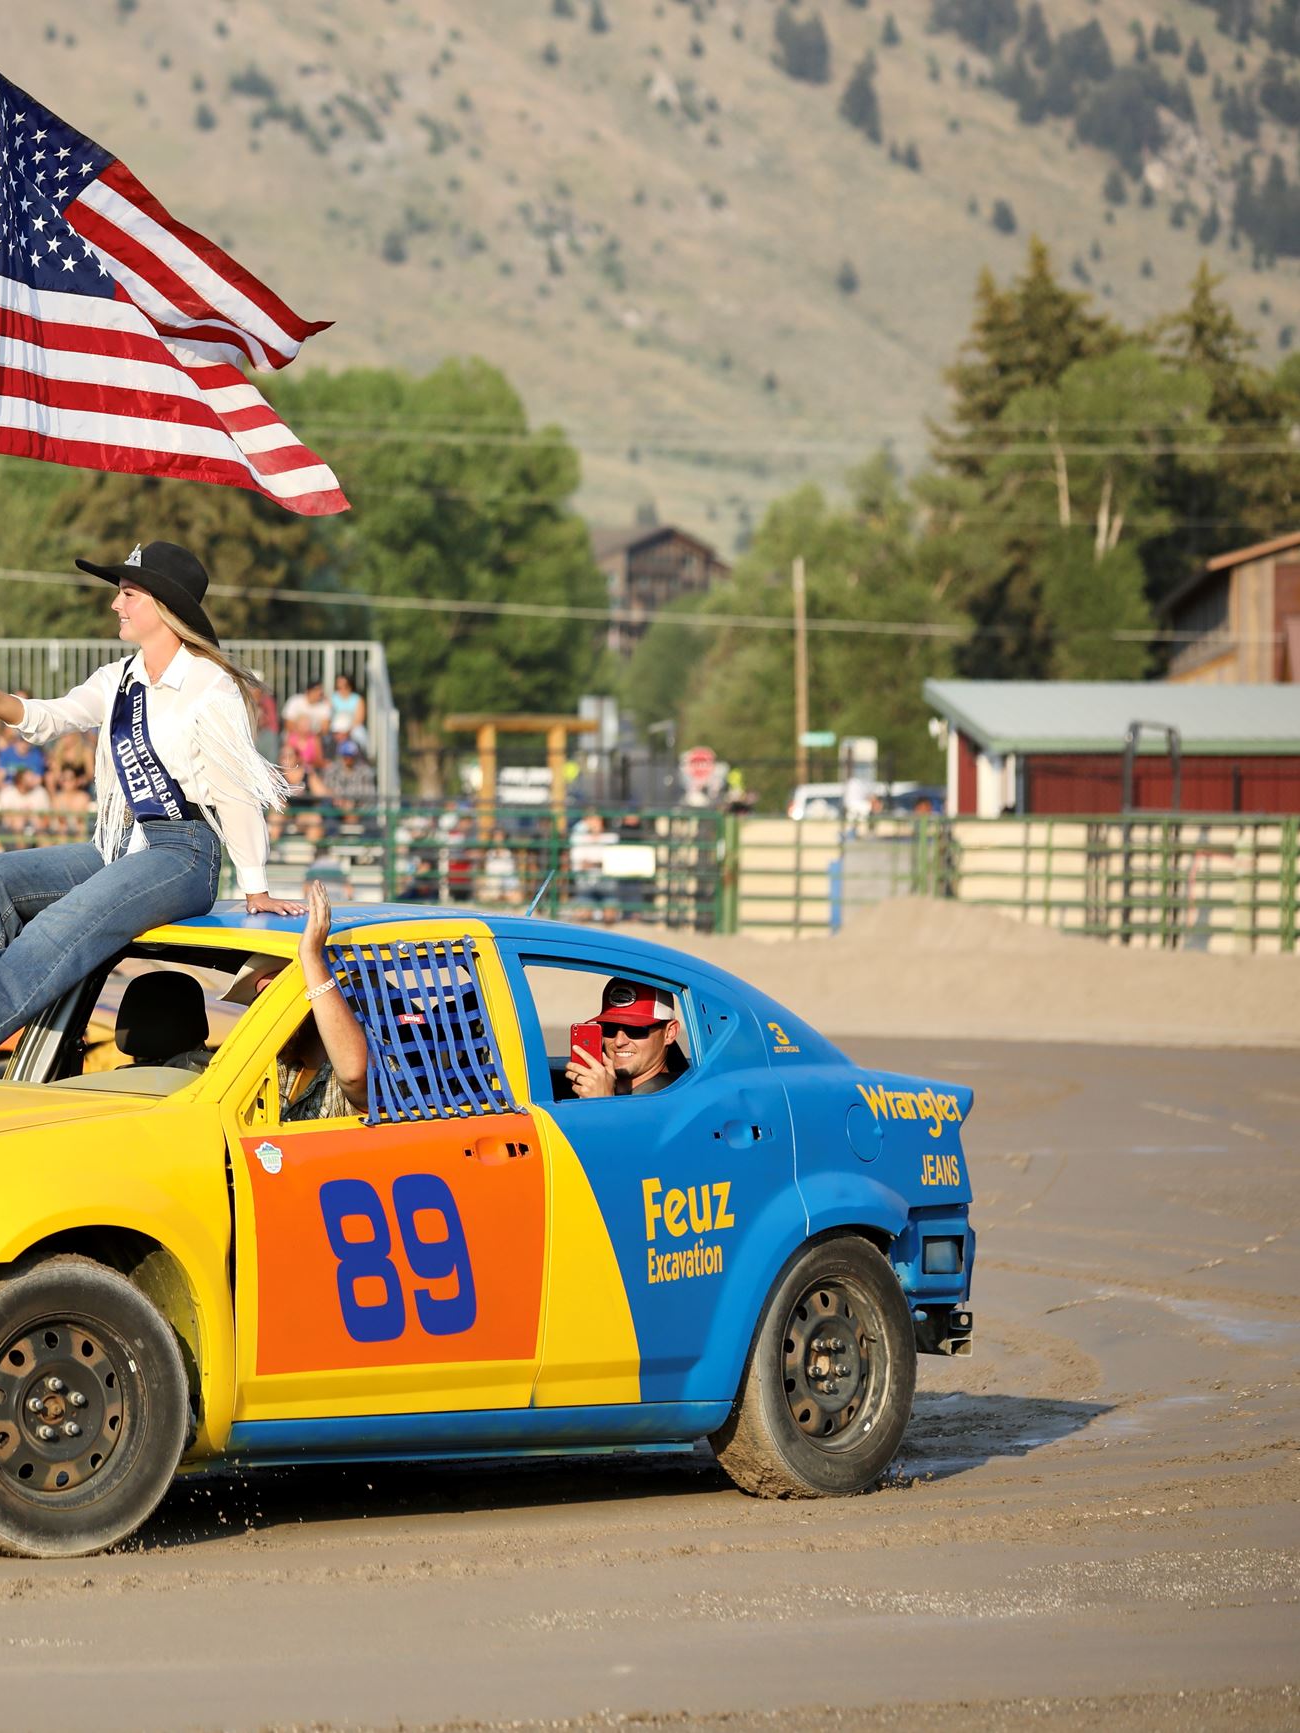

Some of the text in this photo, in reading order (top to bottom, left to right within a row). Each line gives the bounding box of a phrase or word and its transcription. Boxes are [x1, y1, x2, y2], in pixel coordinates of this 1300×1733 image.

[132, 692, 143, 725] TETON
[132, 723, 155, 767] COUNTY
[116, 738, 154, 804] QUEEN
[148, 764, 168, 794] FAIR
[159, 791, 172, 803] &
[766, 1022, 790, 1045] 3
[855, 1083, 963, 1138] Wrangler
[920, 1154, 960, 1186] JEANS
[641, 1177, 735, 1242] Feuz
[319, 1173, 477, 1343] 89
[647, 1237, 723, 1284] Excavation
